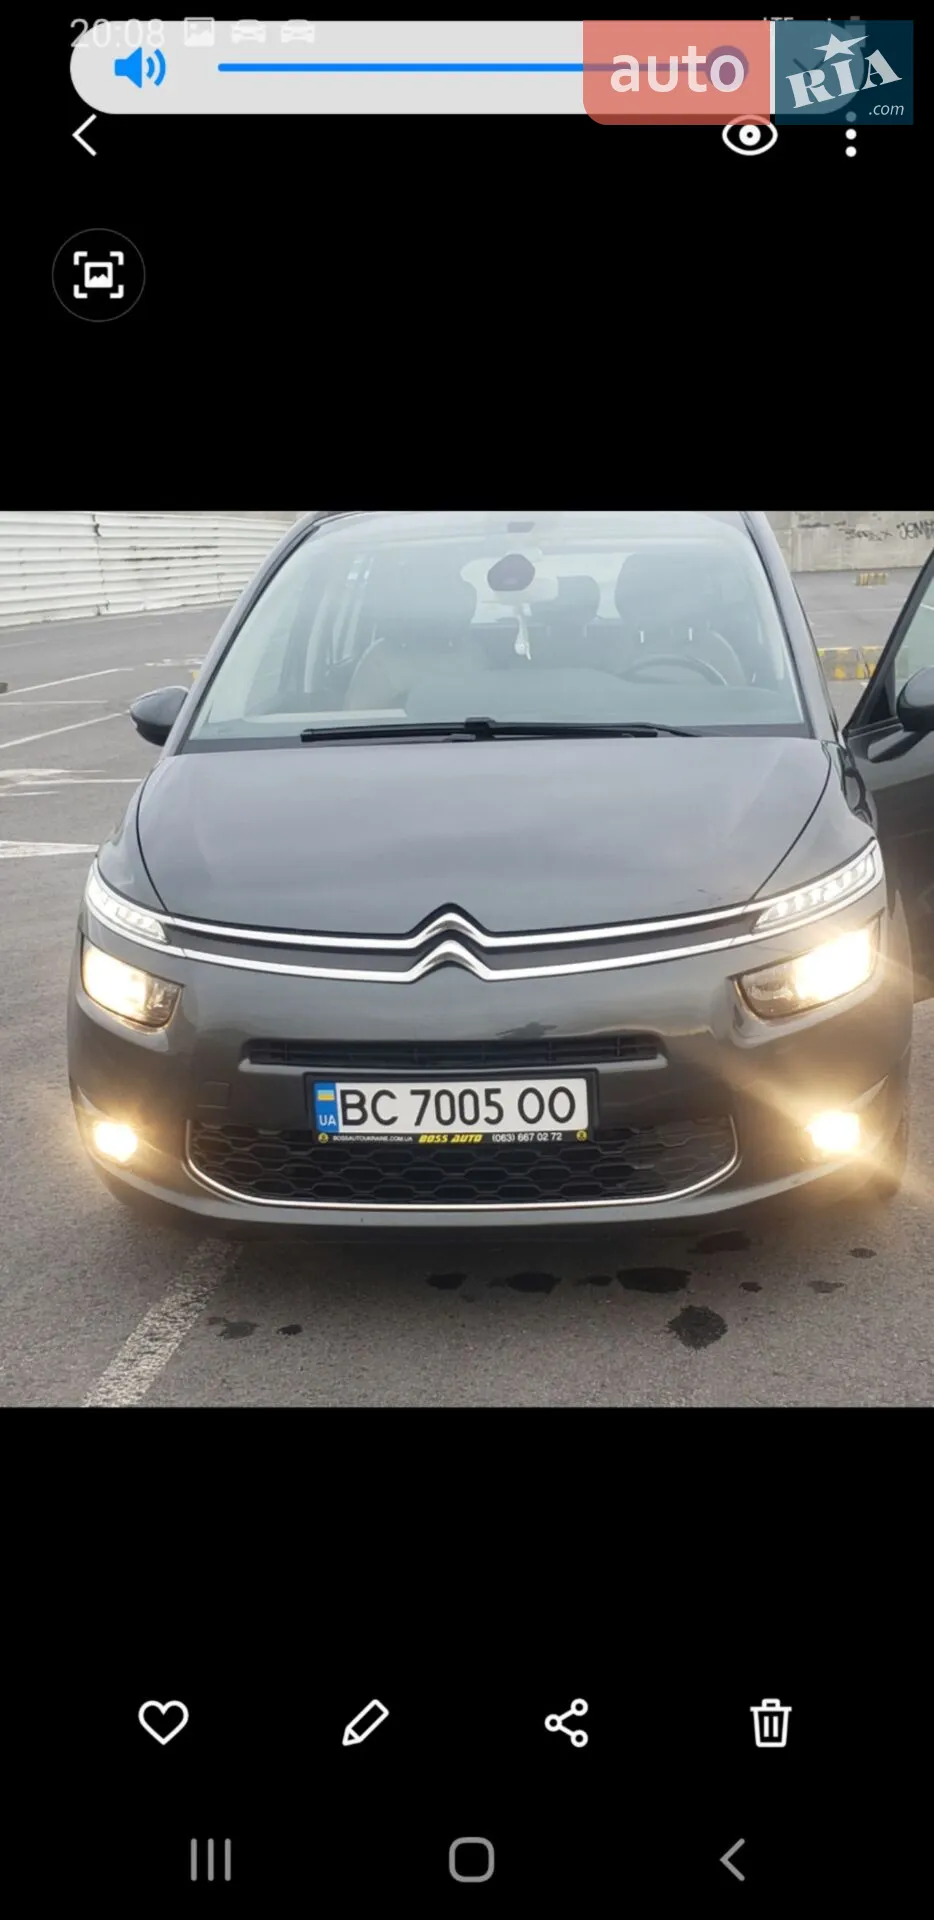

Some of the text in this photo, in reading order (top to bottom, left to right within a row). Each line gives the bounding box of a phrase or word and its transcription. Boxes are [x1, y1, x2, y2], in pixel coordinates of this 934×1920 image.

[339, 1086, 576, 1126] BC 7005 OO
[319, 1115, 336, 1126] UA
[418, 1134, 449, 1144] BOSS
[450, 1134, 483, 1143] AUTO
[492, 1133, 515, 1143] (063)
[536, 1132, 549, 1141] 02
[551, 1132, 563, 1141] 72
